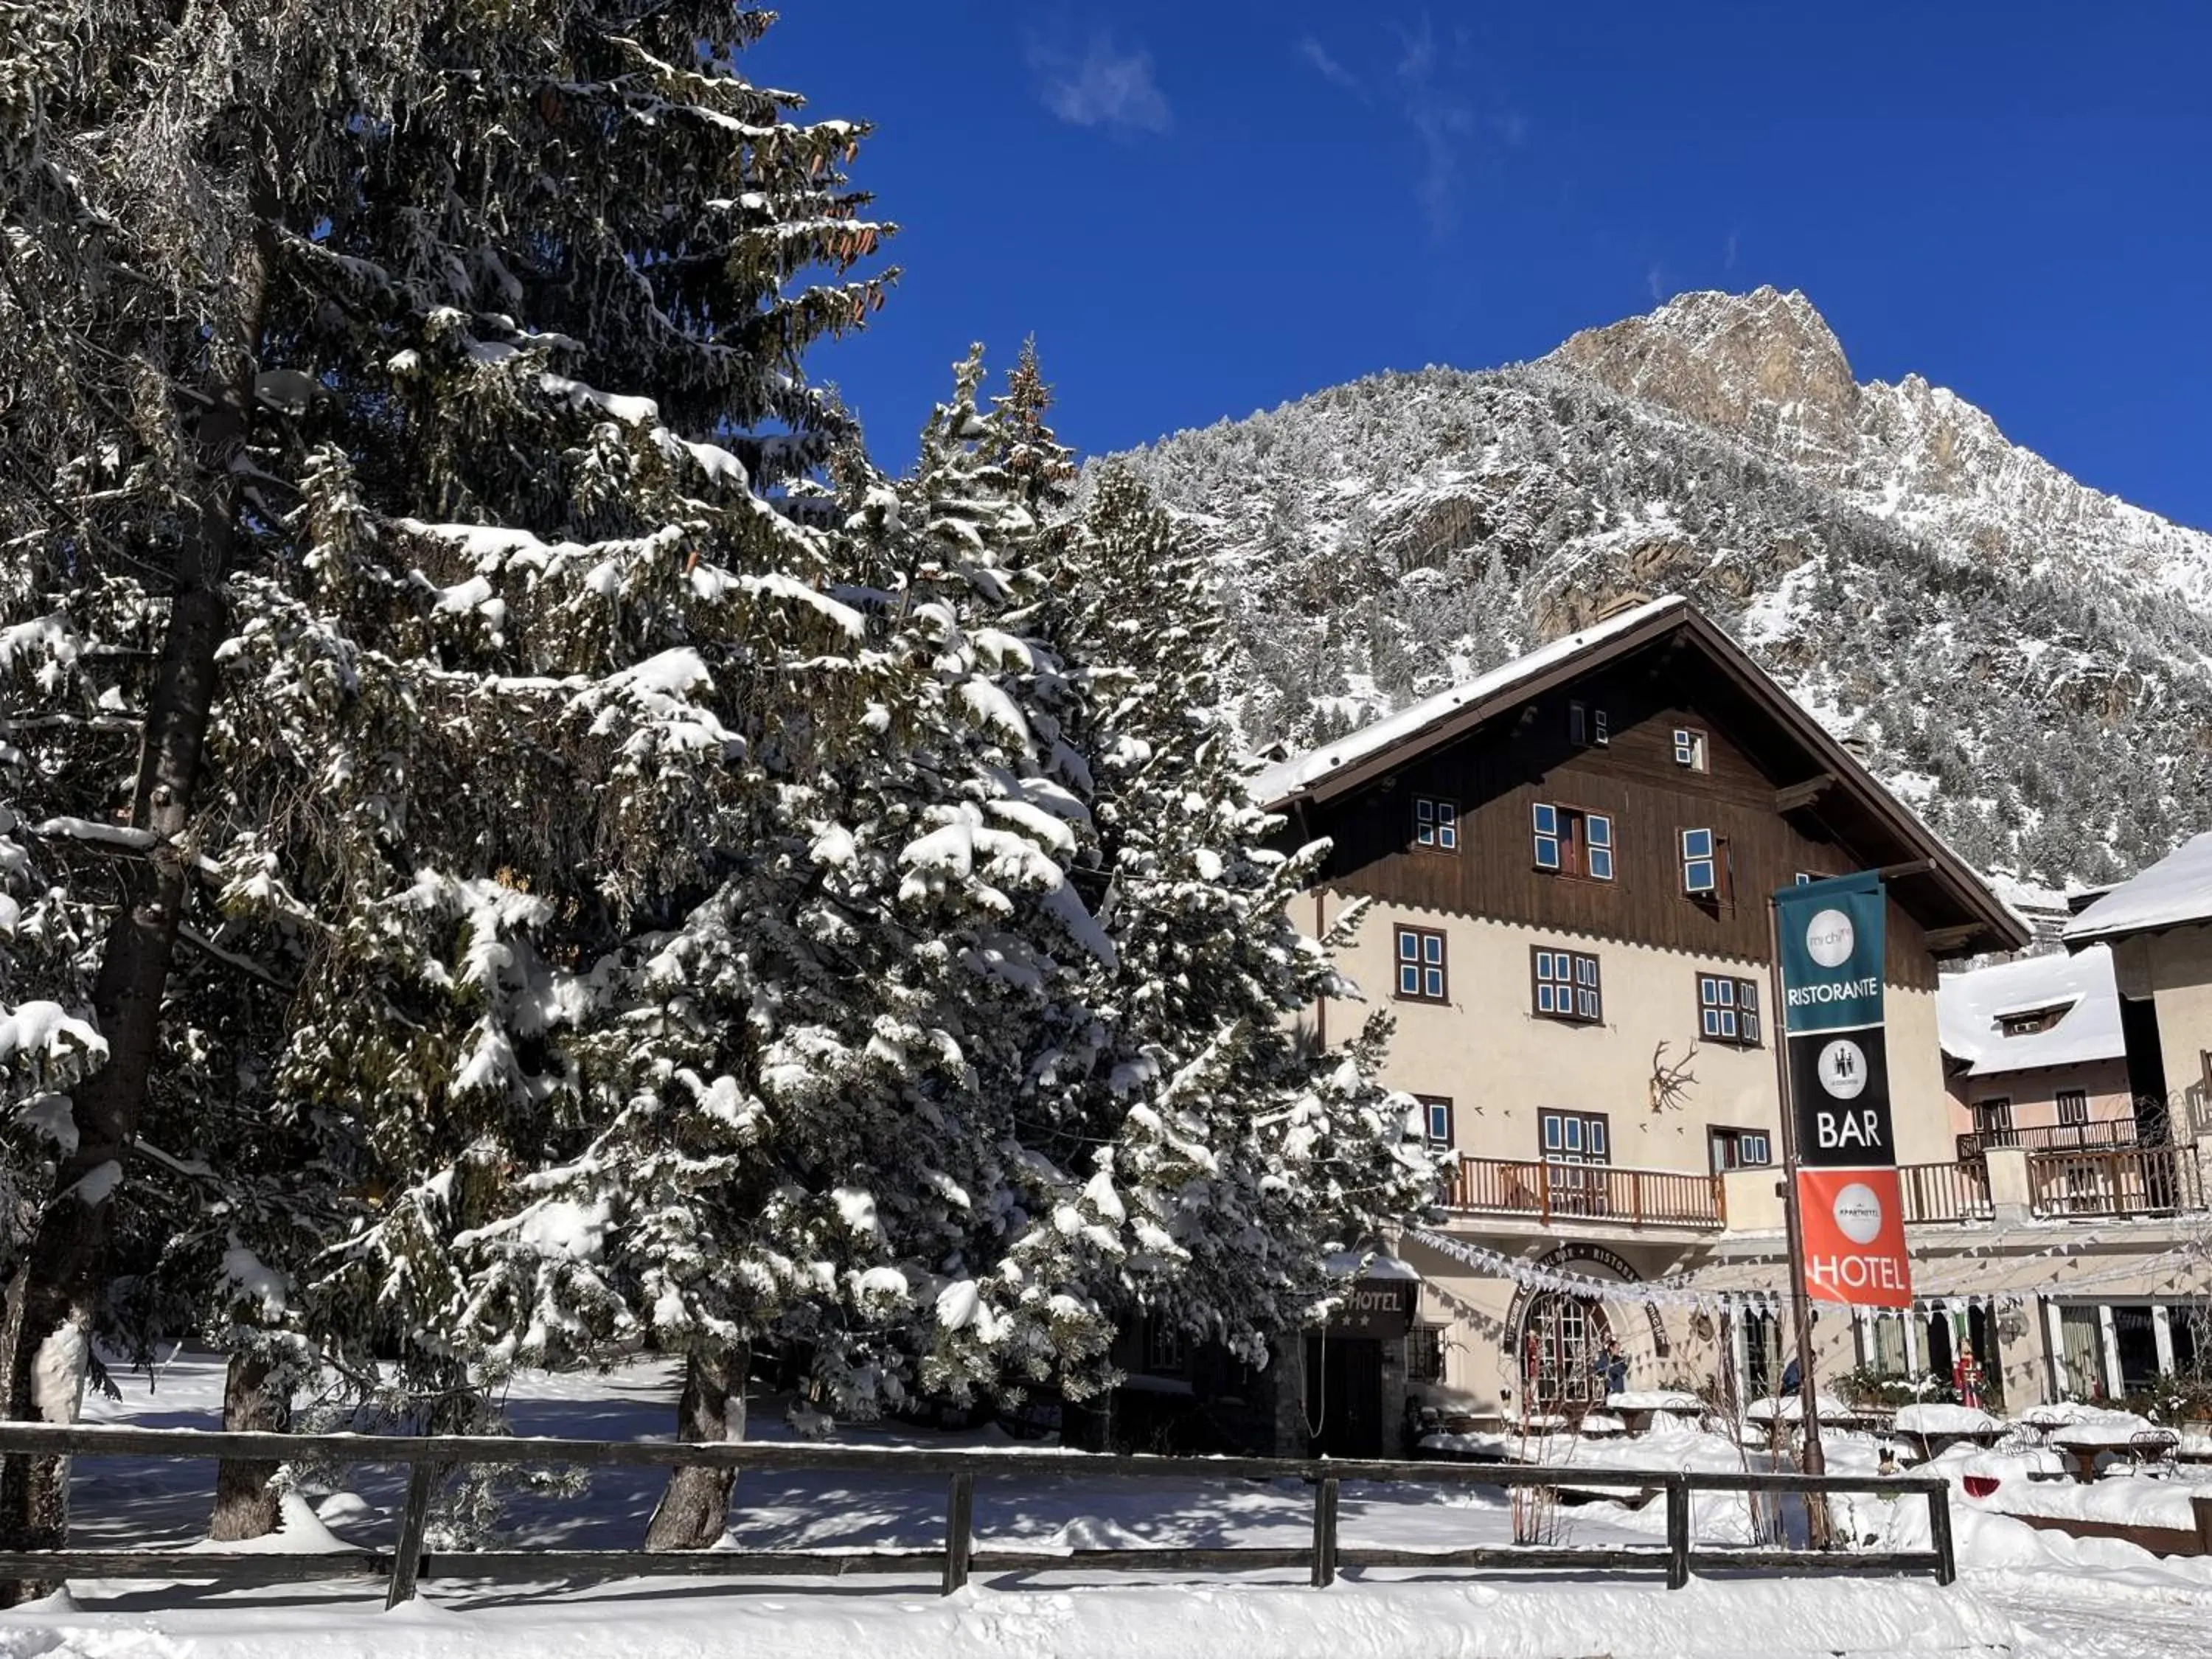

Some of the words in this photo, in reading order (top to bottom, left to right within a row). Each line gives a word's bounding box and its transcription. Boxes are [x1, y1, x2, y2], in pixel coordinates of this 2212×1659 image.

[1788, 977, 1878, 1006] RISTORANTE
[1817, 1109, 1882, 1148] BAR
[1813, 1254, 1905, 1290] HOTEL
[1348, 1291, 1402, 1312] HOTEL
